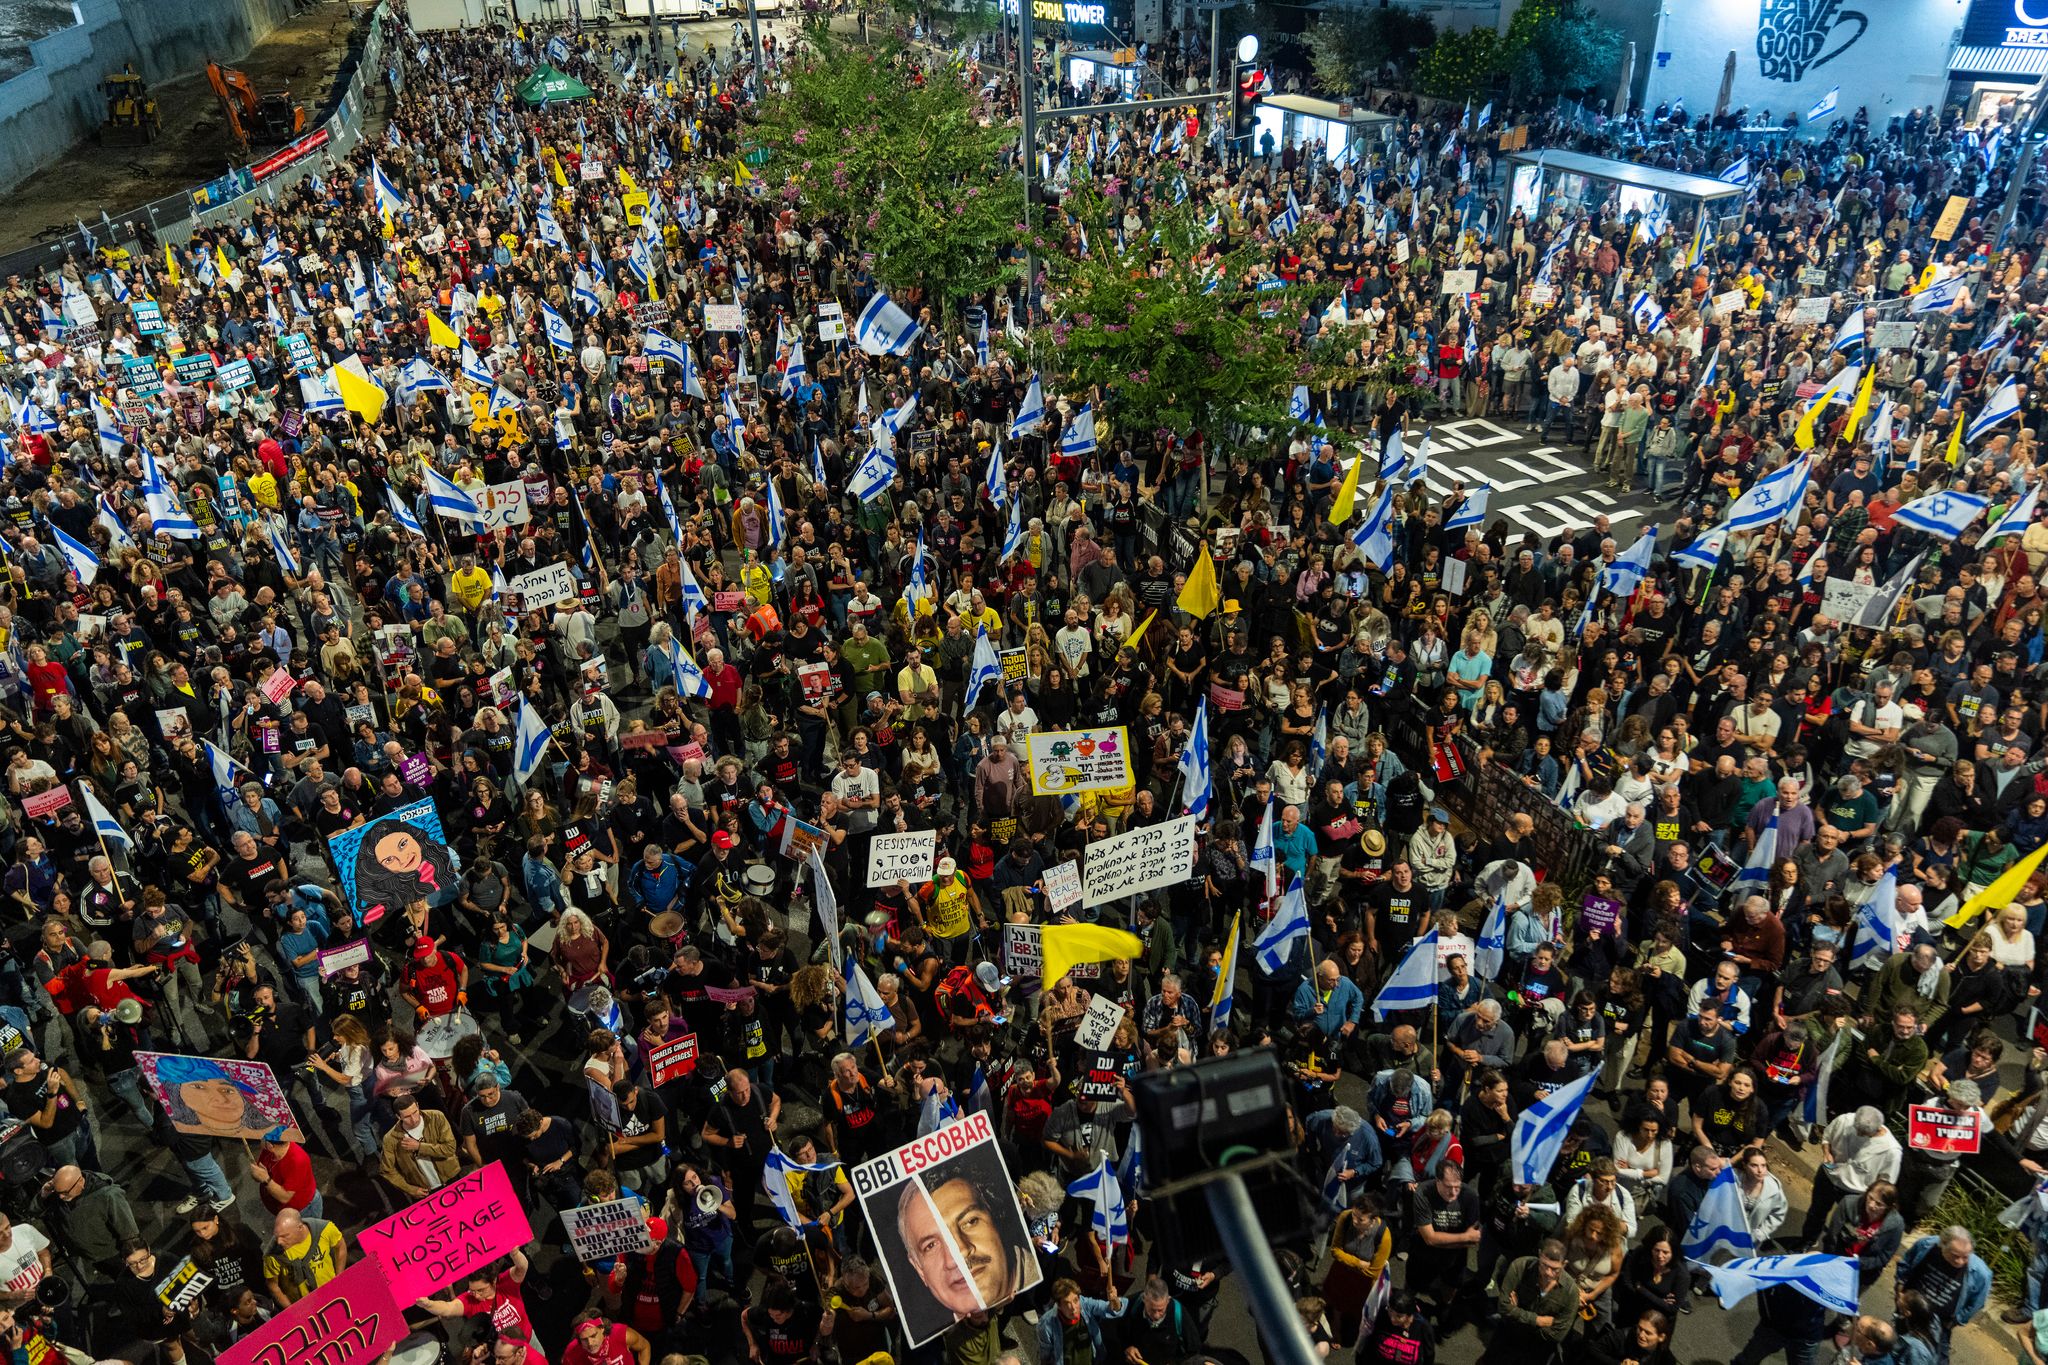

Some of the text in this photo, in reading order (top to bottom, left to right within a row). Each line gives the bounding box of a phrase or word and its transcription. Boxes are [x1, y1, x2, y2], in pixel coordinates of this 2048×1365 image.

[1033, 1, 1065, 22] SPIRAL
[1065, 2, 1105, 25] TOWER
[1756, 26, 1826, 62] GOOD
[1760, 60, 1810, 83] DAY
[551, 567, 566, 583] אין
[559, 584, 570, 597] על
[408, 758, 420, 769] לא
[1078, 763, 1094, 773] מר
[401, 807, 431, 820] דניאלה
[566, 827, 580, 840] עם
[1657, 823, 1680, 832] SEAL
[875, 838, 934, 852] RESISTANCE
[1085, 822, 1188, 864] יוני הקריב את עצמו
[1140, 842, 1166, 859] להציל
[1124, 851, 1137, 861] את
[248, 861, 273, 876] CRIME
[872, 866, 932, 882] DICTATORSHIP
[1045, 862, 1075, 880] LIVES
[1087, 850, 1189, 889] ביבי מקריב את החטופים
[1060, 873, 1078, 884] lies
[1091, 863, 1188, 899] כדי להציל את עצמו
[1050, 881, 1079, 899] DEALS
[1052, 890, 1084, 908] not deaths
[1593, 903, 1610, 912] לא
[1012, 928, 1026, 942] על
[426, 985, 445, 996] אתה
[428, 993, 448, 1004] אשם
[1104, 1004, 1116, 1015] די
[1089, 1020, 1110, 1033] STOP
[1082, 1033, 1100, 1052] WAR
[1091, 1029, 1102, 1041] THE
[652, 1038, 695, 1062] ISRAELIS CHOOSE
[655, 1047, 693, 1071] THE HOSTAGES!
[1096, 1057, 1114, 1071] עם
[1936, 1127, 1974, 1140] עכשיו
[854, 1113, 992, 1196] BIBI ESCOBAR
[375, 1172, 484, 1240] VICTORY
[576, 1203, 624, 1219] נתניהו
[575, 1218, 638, 1236] מפקירים
[392, 1199, 507, 1272] HOSTAGE
[574, 1225, 646, 1247] את ביטחון
[587, 1236, 639, 1251] המדינה
[582, 1239, 650, 1260] והחטופים
[425, 1235, 497, 1282] DEAL
